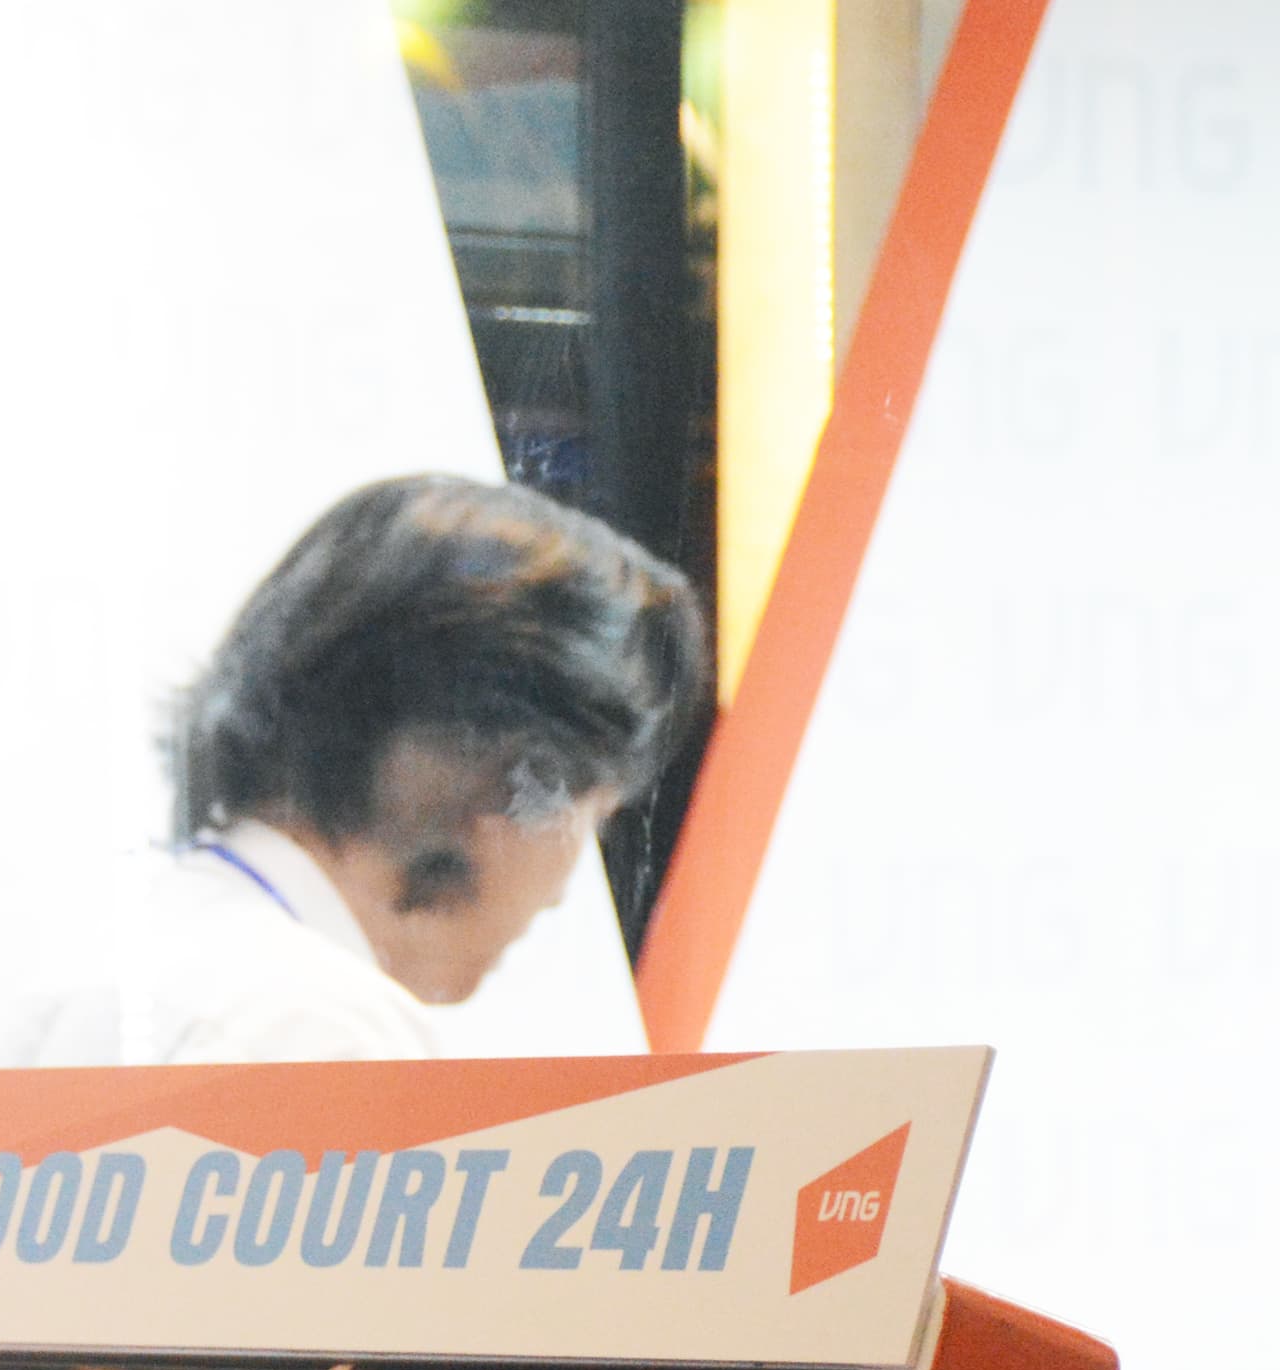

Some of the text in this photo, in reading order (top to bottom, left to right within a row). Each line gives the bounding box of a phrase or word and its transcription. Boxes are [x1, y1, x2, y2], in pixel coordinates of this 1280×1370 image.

[170, 1149, 510, 1268] COURT
[519, 1146, 756, 1271] 24H
[818, 1190, 880, 1222] VNG
